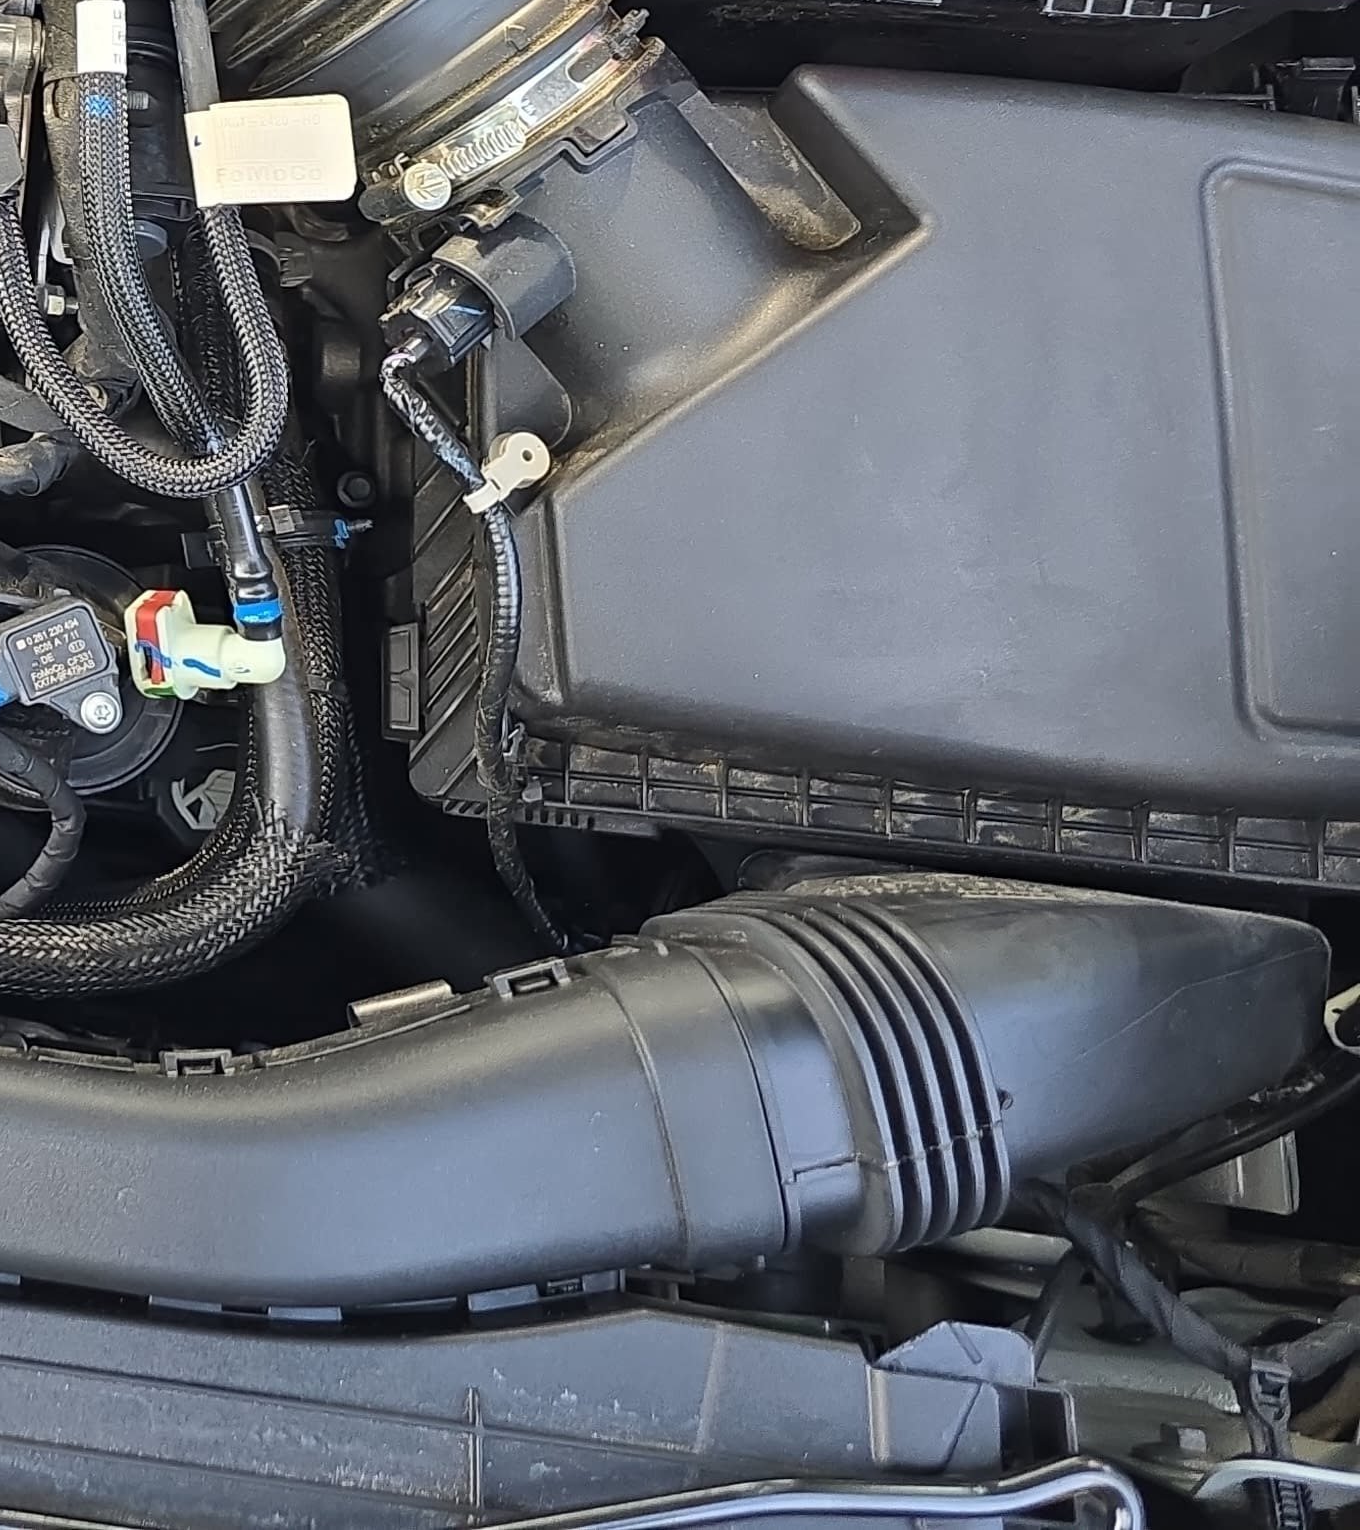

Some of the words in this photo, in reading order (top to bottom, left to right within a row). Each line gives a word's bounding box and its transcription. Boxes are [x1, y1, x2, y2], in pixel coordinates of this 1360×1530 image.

[54, 638, 62, 647] A
[40, 653, 55, 664] DE
[31, 664, 65, 680] FoMoCo
